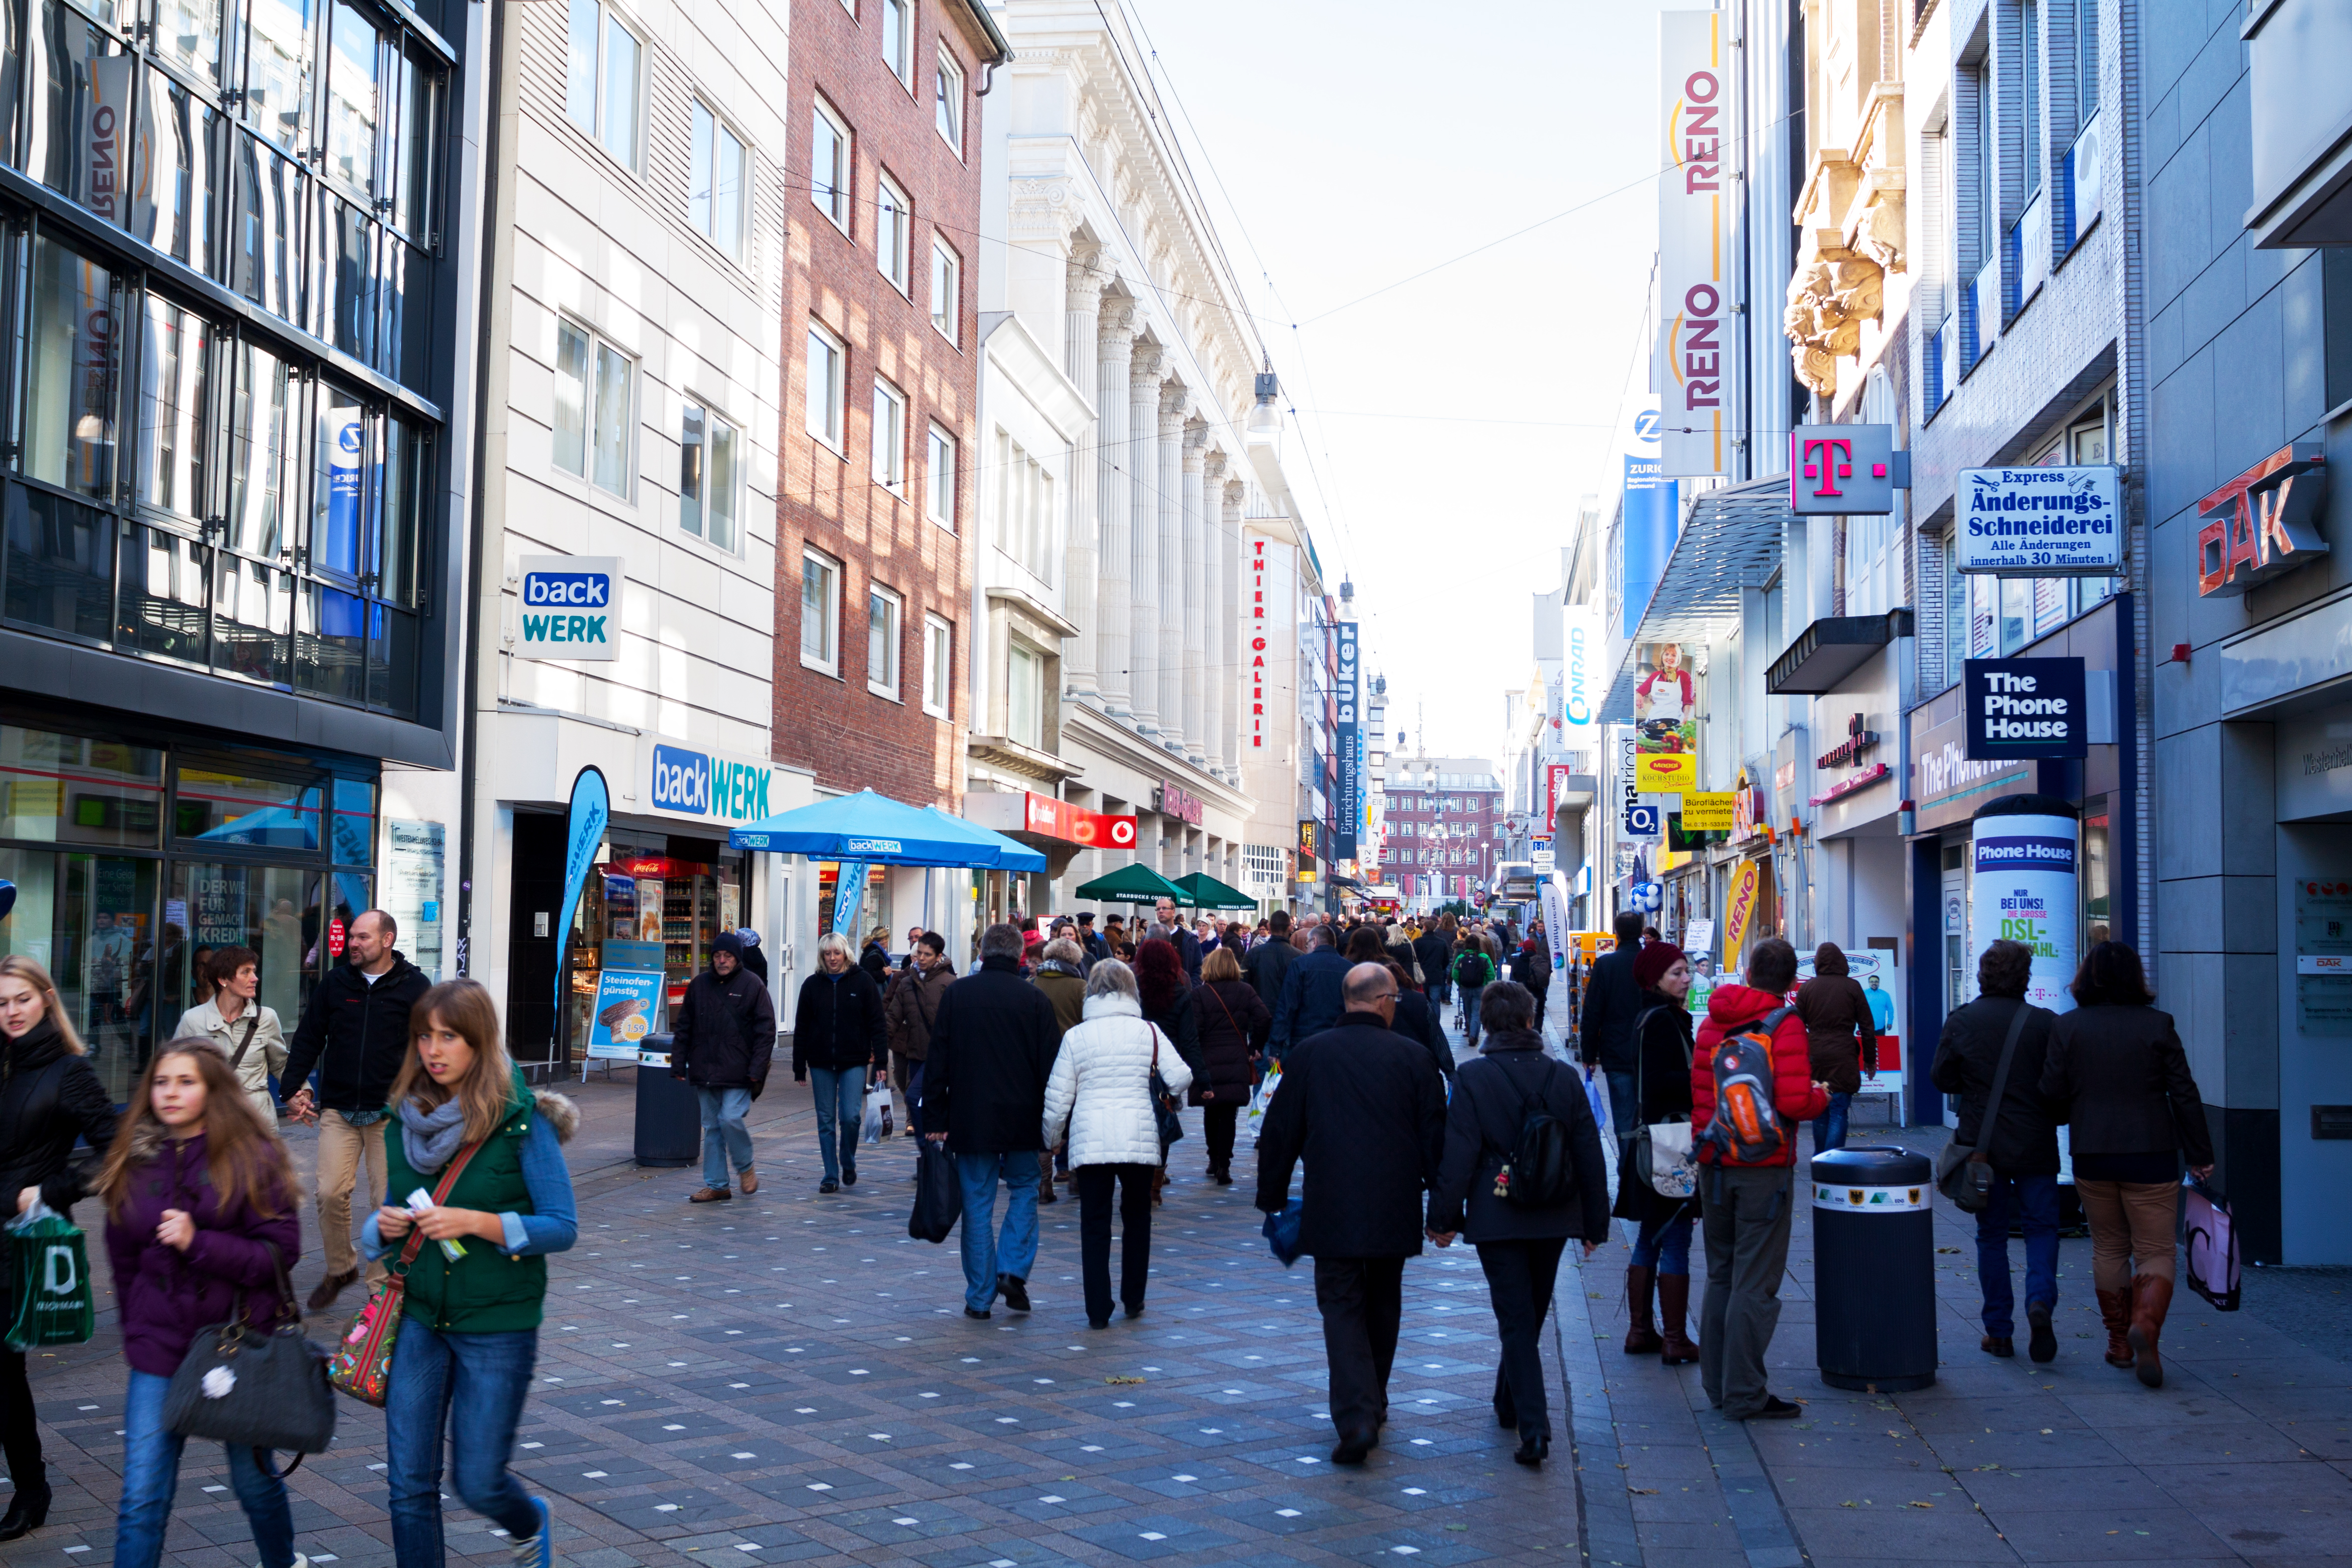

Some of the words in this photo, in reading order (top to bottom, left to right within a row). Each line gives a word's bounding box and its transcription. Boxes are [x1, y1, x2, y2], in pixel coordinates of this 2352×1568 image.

[1685, 71, 1719, 195] RENO
[1685, 284, 1720, 411] RENO
[2002, 471, 2064, 486] Express
[1971, 488, 2110, 514] Änderungs-
[1969, 514, 2112, 537] Schneiderei
[2198, 442, 2295, 598] DAK
[1990, 540, 2015, 550] Alle
[2019, 537, 2091, 551] Änderungen
[1970, 555, 2027, 566] innerhalb
[2031, 552, 2051, 565] 30
[2055, 554, 2105, 564] Minuten
[529, 575, 605, 604] back
[523, 614, 606, 643] WERK
[1338, 626, 1354, 723] büker
[1984, 672, 2036, 692] The
[1985, 695, 2068, 715] Phone
[1986, 718, 2068, 738] House
[1341, 735, 1355, 835] Einrichtungshaus
[1662, 780, 1694, 789] Dortmund
[850, 839, 901, 853] backWERK
[1979, 845, 2025, 860] Phone
[2026, 844, 2072, 861] House
[200, 879, 228, 894] DER
[2013, 889, 2028, 897] NUR
[199, 894, 226, 912] FÜR
[1728, 870, 1755, 943] RENO
[2001, 898, 2017, 910] BEI
[2019, 898, 2044, 910] UNS!
[1551, 896, 1560, 949] unitymedia
[2020, 910, 2048, 919] GROSSE
[2001, 918, 2047, 941] DSL-
[2316, 958, 2342, 967] DAK
[604, 975, 653, 986] Steinofen-
[603, 986, 639, 997] günstig
[626, 1024, 644, 1034] 1.59
[44, 1245, 77, 1295] D
